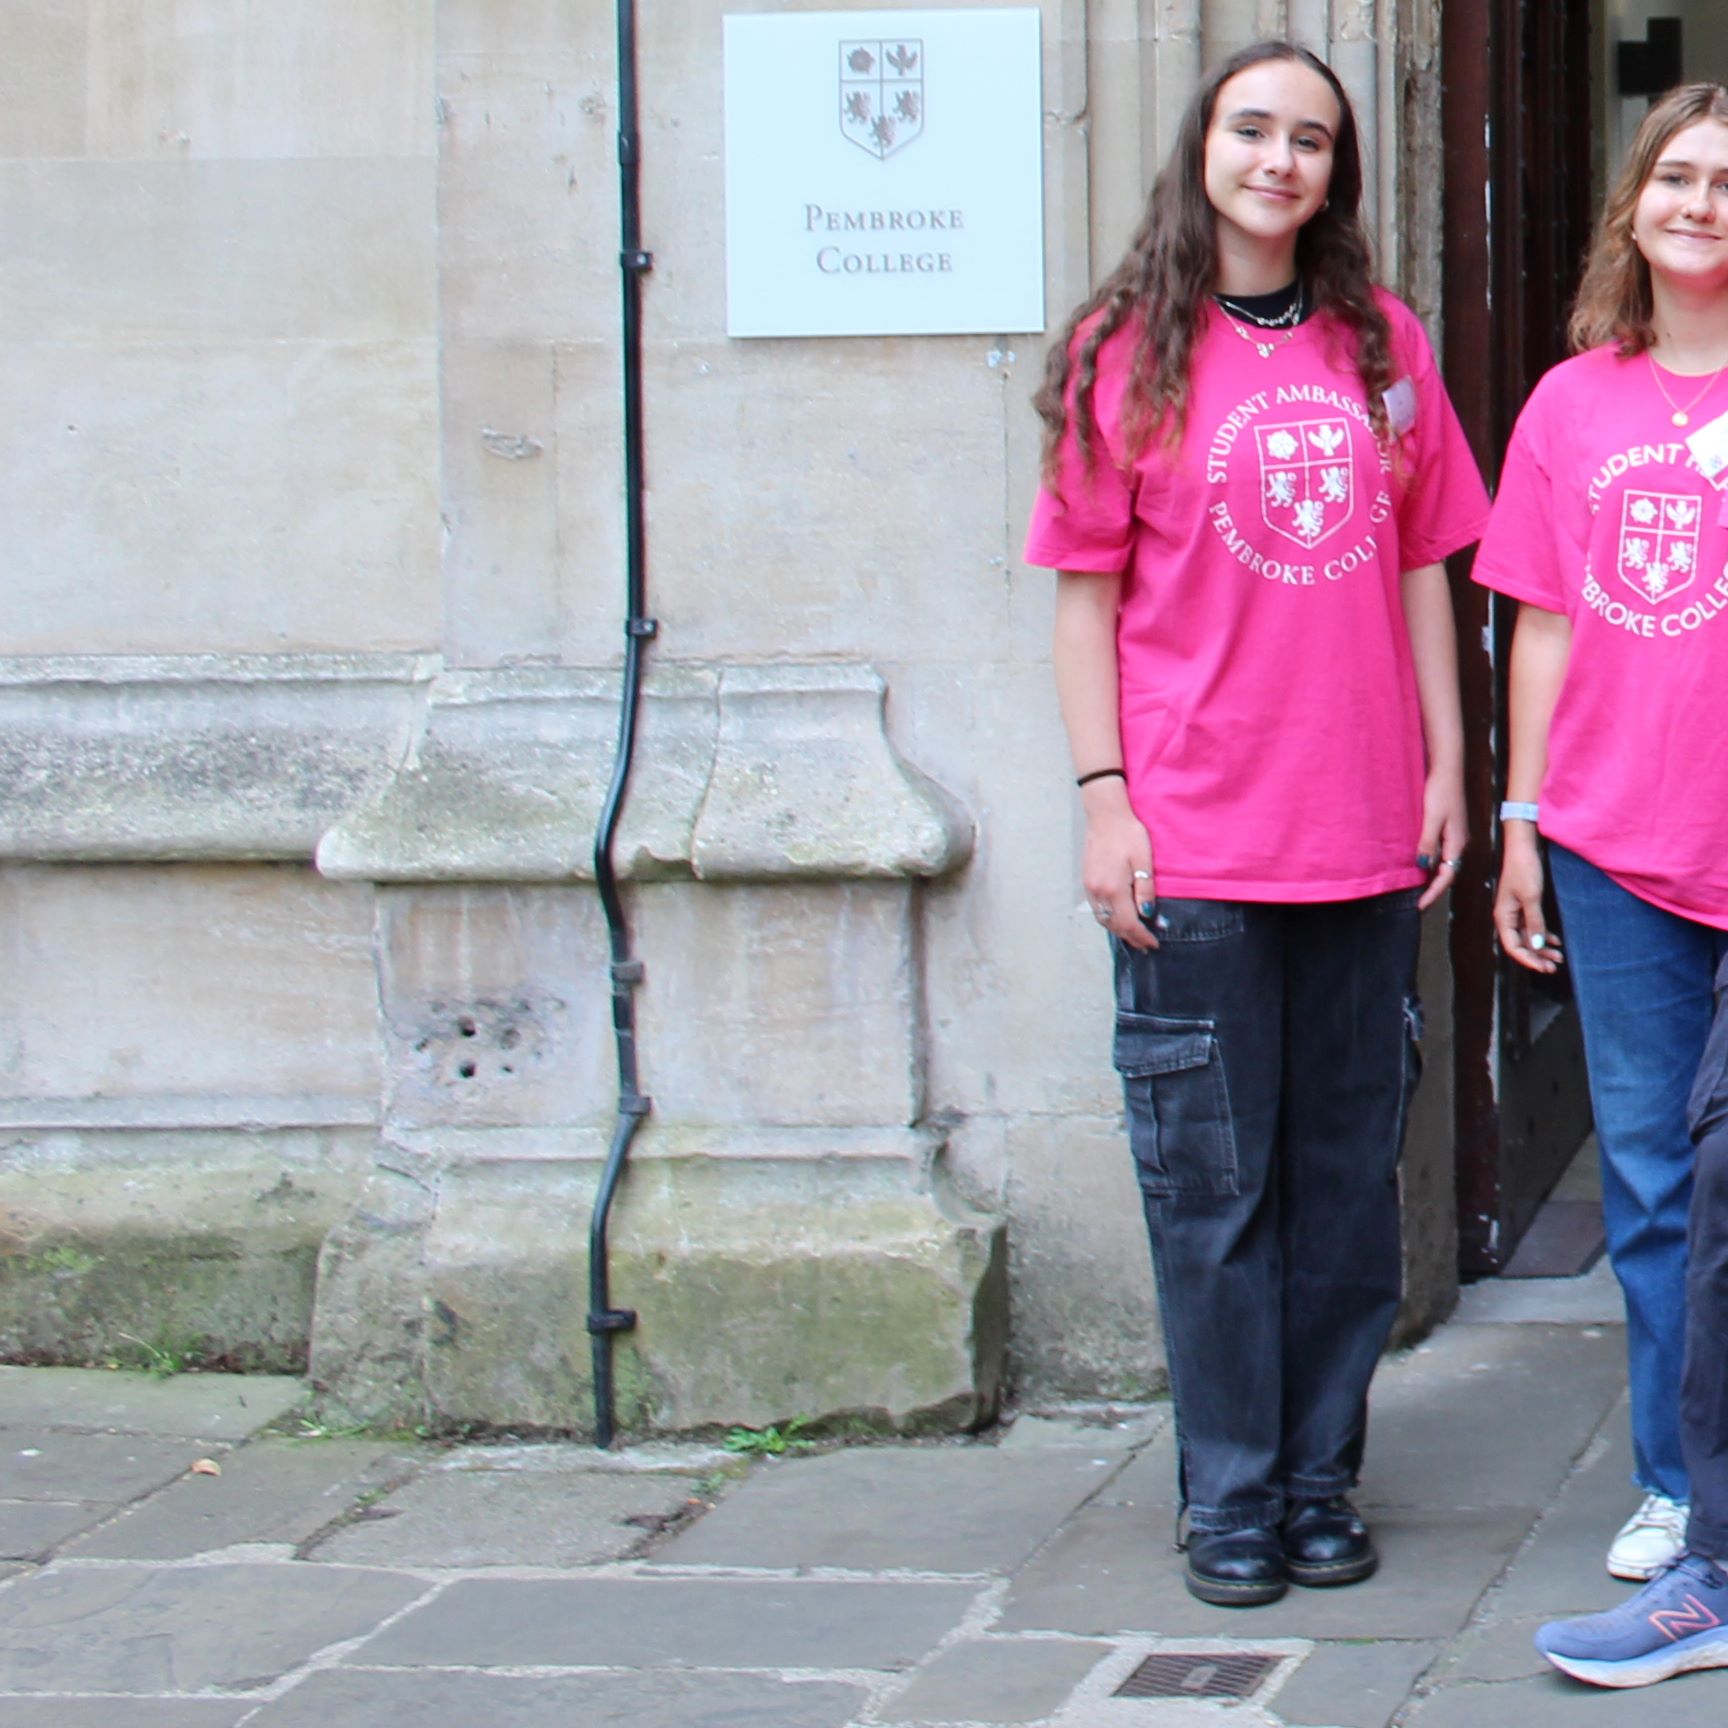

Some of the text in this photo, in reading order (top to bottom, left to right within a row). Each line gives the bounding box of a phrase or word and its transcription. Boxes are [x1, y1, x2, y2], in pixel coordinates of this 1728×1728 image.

[804, 203, 965, 233] PEMBROKE
[815, 245, 954, 275] COLLEGE
[1206, 391, 1270, 485] STUDENT
[1208, 500, 1316, 586] PEMBROKE
